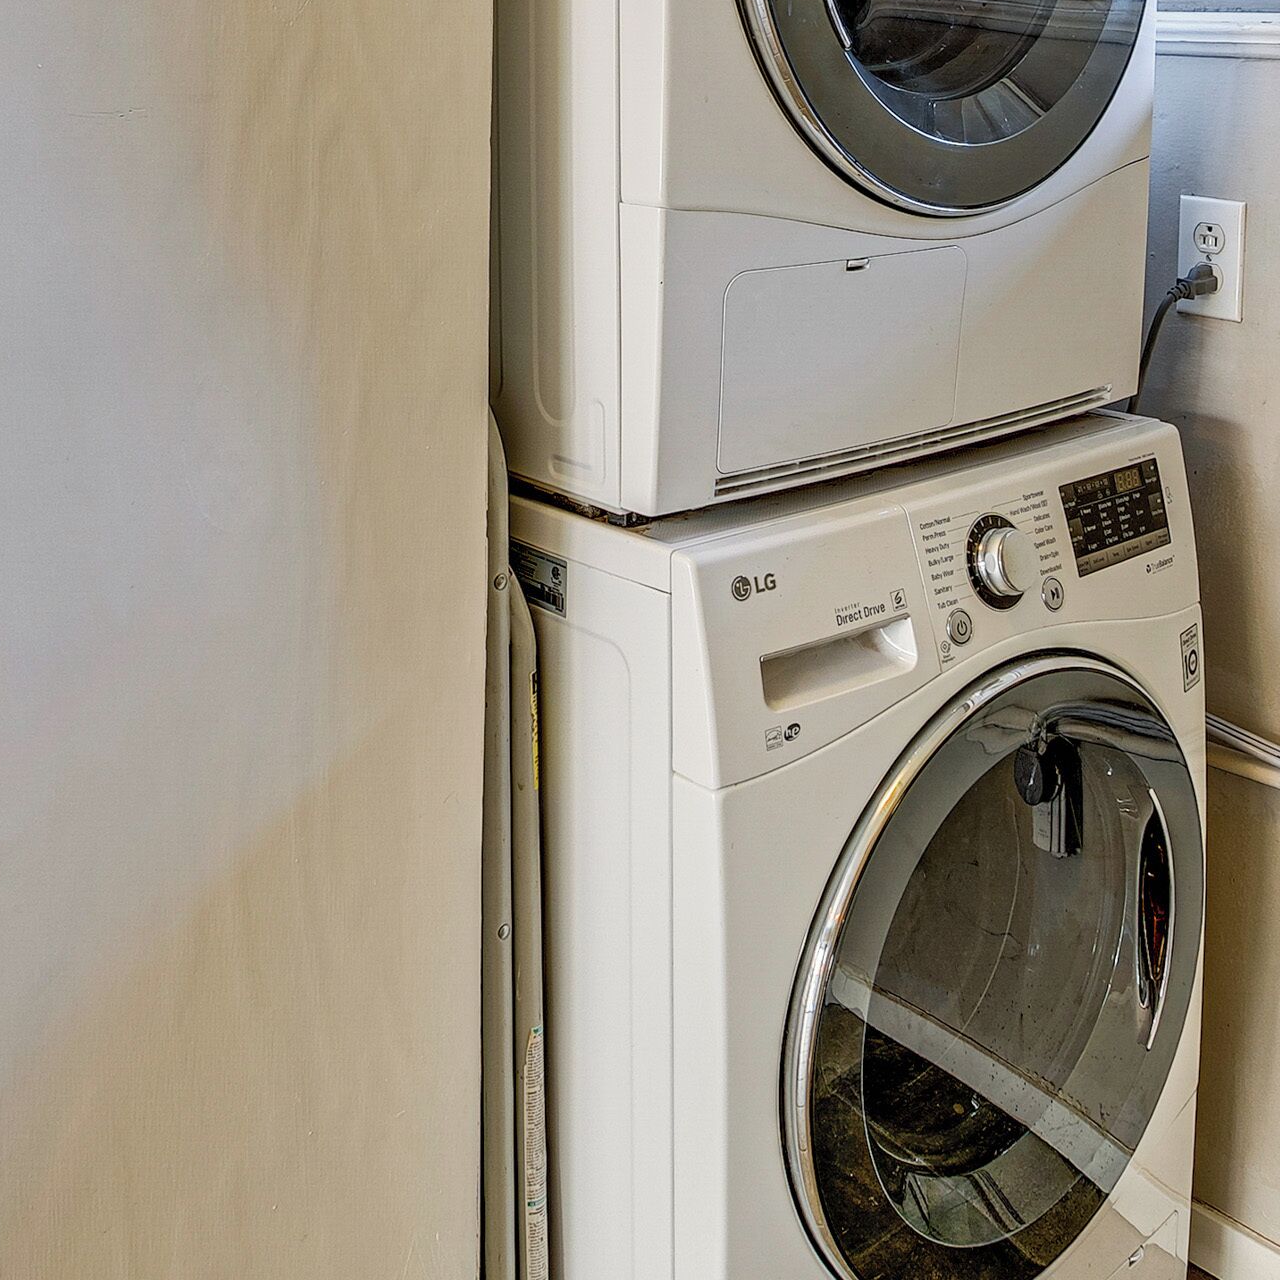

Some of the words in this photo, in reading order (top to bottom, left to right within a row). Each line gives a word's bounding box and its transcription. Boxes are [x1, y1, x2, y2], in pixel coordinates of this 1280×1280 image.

[754, 572, 777, 594] LG
[834, 601, 861, 613] Inverter
[836, 609, 863, 626] Direct
[863, 602, 886, 618] Drive
